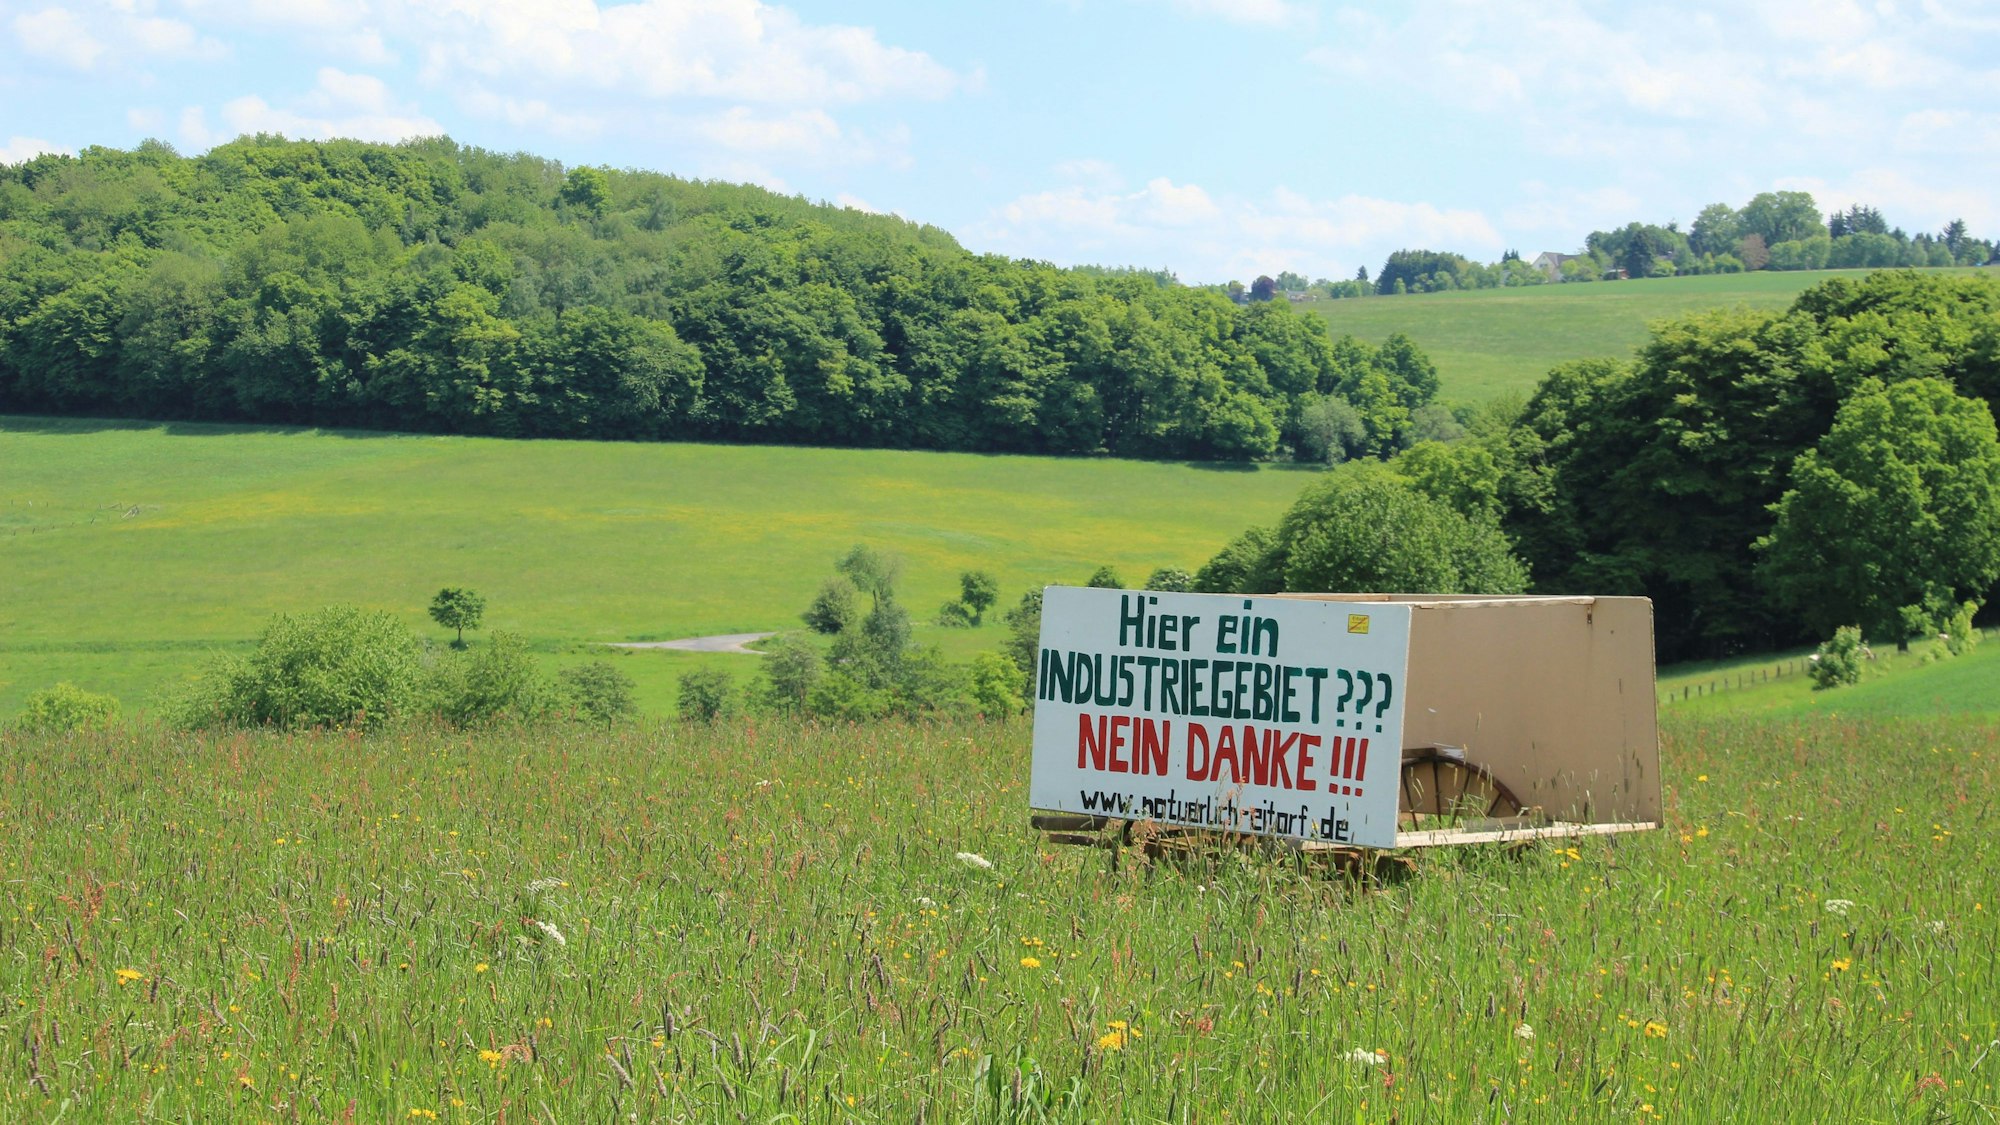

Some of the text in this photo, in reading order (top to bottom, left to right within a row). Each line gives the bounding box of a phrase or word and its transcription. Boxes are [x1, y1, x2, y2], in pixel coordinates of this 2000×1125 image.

[1119, 594, 1279, 658] Hier ein
[1077, 713, 1170, 777] NEIN
